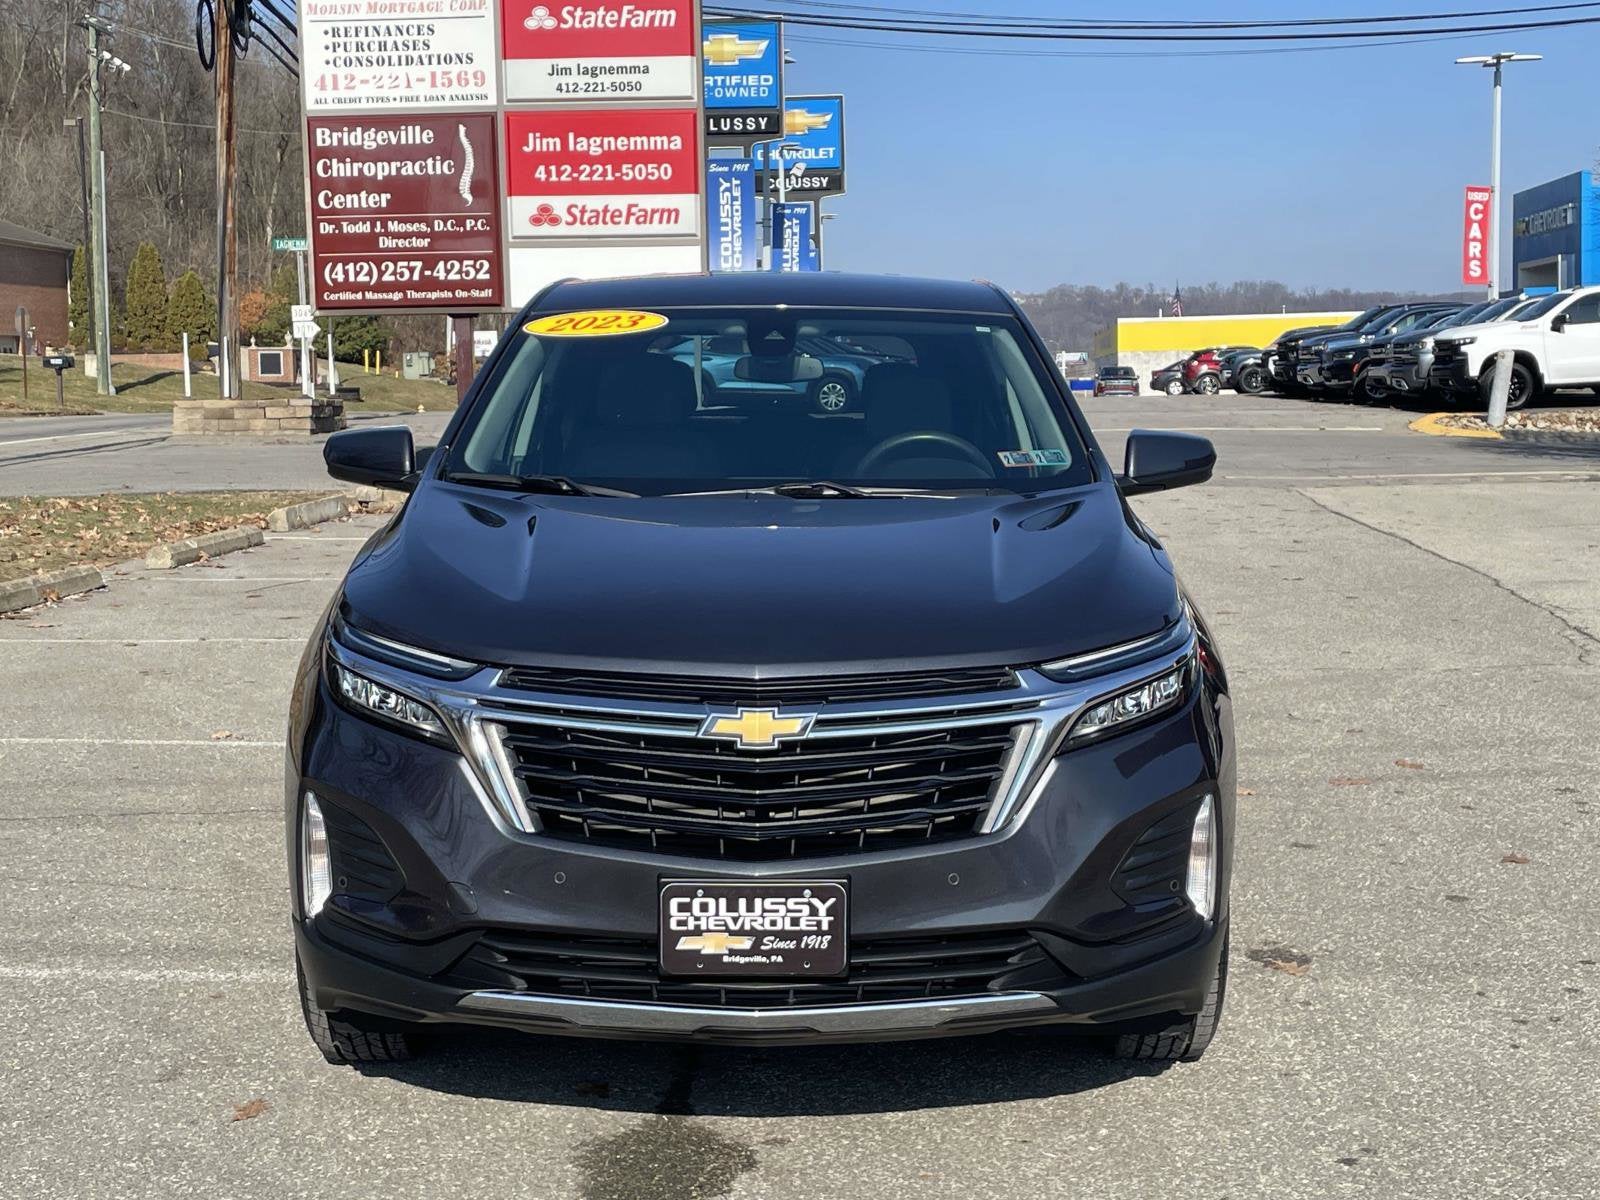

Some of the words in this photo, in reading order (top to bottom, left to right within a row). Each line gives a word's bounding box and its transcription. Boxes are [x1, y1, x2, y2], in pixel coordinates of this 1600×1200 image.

[366, 1, 443, 14] MORTGAGE
[331, 24, 435, 38] REFINANCES
[332, 39, 431, 53] PURCHASES
[332, 53, 474, 68] CONSOLIDATIONS
[547, 63, 572, 77] Jim
[577, 63, 650, 78] Iagnemma
[314, 70, 486, 91] 412-221-1569
[556, 81, 642, 93] 412-221-5050
[314, 97, 329, 105] ALL
[332, 96, 362, 105] CREDIT
[365, 95, 391, 104] TYPES
[400, 95, 421, 103] FREE
[424, 94, 446, 102] LOAN
[449, 93, 488, 102] ANALYSIS
[316, 125, 434, 150] Bridgeville
[522, 133, 561, 152] Jim
[568, 132, 682, 156] Iagnemma
[316, 156, 455, 180] Chiropractic
[534, 163, 673, 182] 412-221-5050
[709, 163, 729, 172] Since
[732, 163, 750, 172] 1918
[318, 190, 391, 209] Center
[1467, 191, 1490, 201] USED
[319, 222, 339, 234] Dr.
[341, 221, 370, 233] Todd
[374, 221, 385, 232] J.
[388, 220, 431, 234] Moses,
[434, 219, 464, 233] D.C.,
[466, 218, 490, 231] P.C.
[719, 177, 732, 271] COLUSSY
[732, 177, 742, 271] CHEVROLET
[379, 235, 430, 248] Director
[1469, 203, 1484, 278] CARS
[323, 291, 362, 300] Certified
[365, 290, 404, 301] Massage
[406, 289, 453, 299] Therapists
[455, 288, 493, 298] On-Staff
[546, 314, 646, 332] 2023
[669, 897, 837, 917] COLUSSY
[669, 916, 834, 931] CHEVROLET
[760, 935, 797, 950] Since
[800, 934, 832, 950] 1918
[723, 955, 769, 964] Bridgeville,
